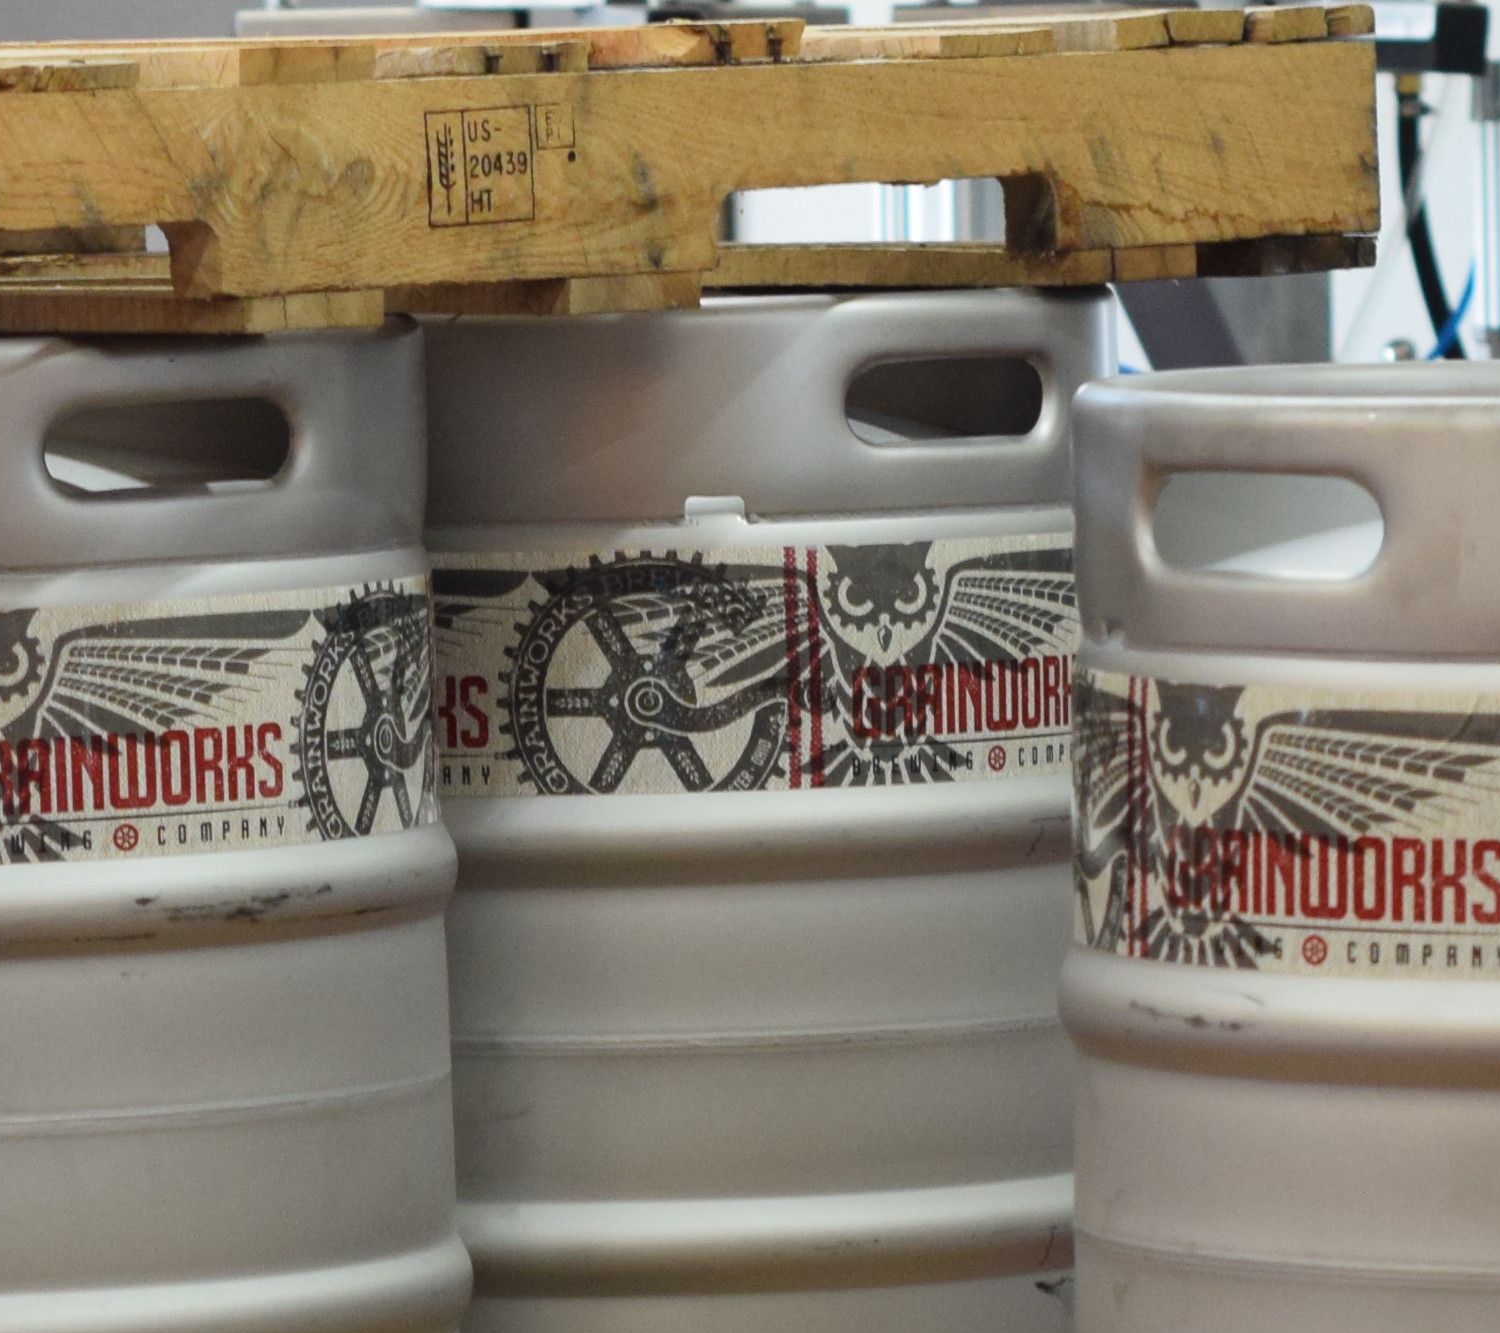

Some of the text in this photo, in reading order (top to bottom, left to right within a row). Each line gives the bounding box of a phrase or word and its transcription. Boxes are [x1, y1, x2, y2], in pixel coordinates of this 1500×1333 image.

[469, 151, 528, 179] 20439
[469, 188, 494, 214] HT
[523, 592, 592, 794] GRAINWORKS
[304, 632, 353, 838] GRAINWORKS
[852, 743, 1064, 777] BREWING COMP
[158, 814, 288, 846] COMPANY
